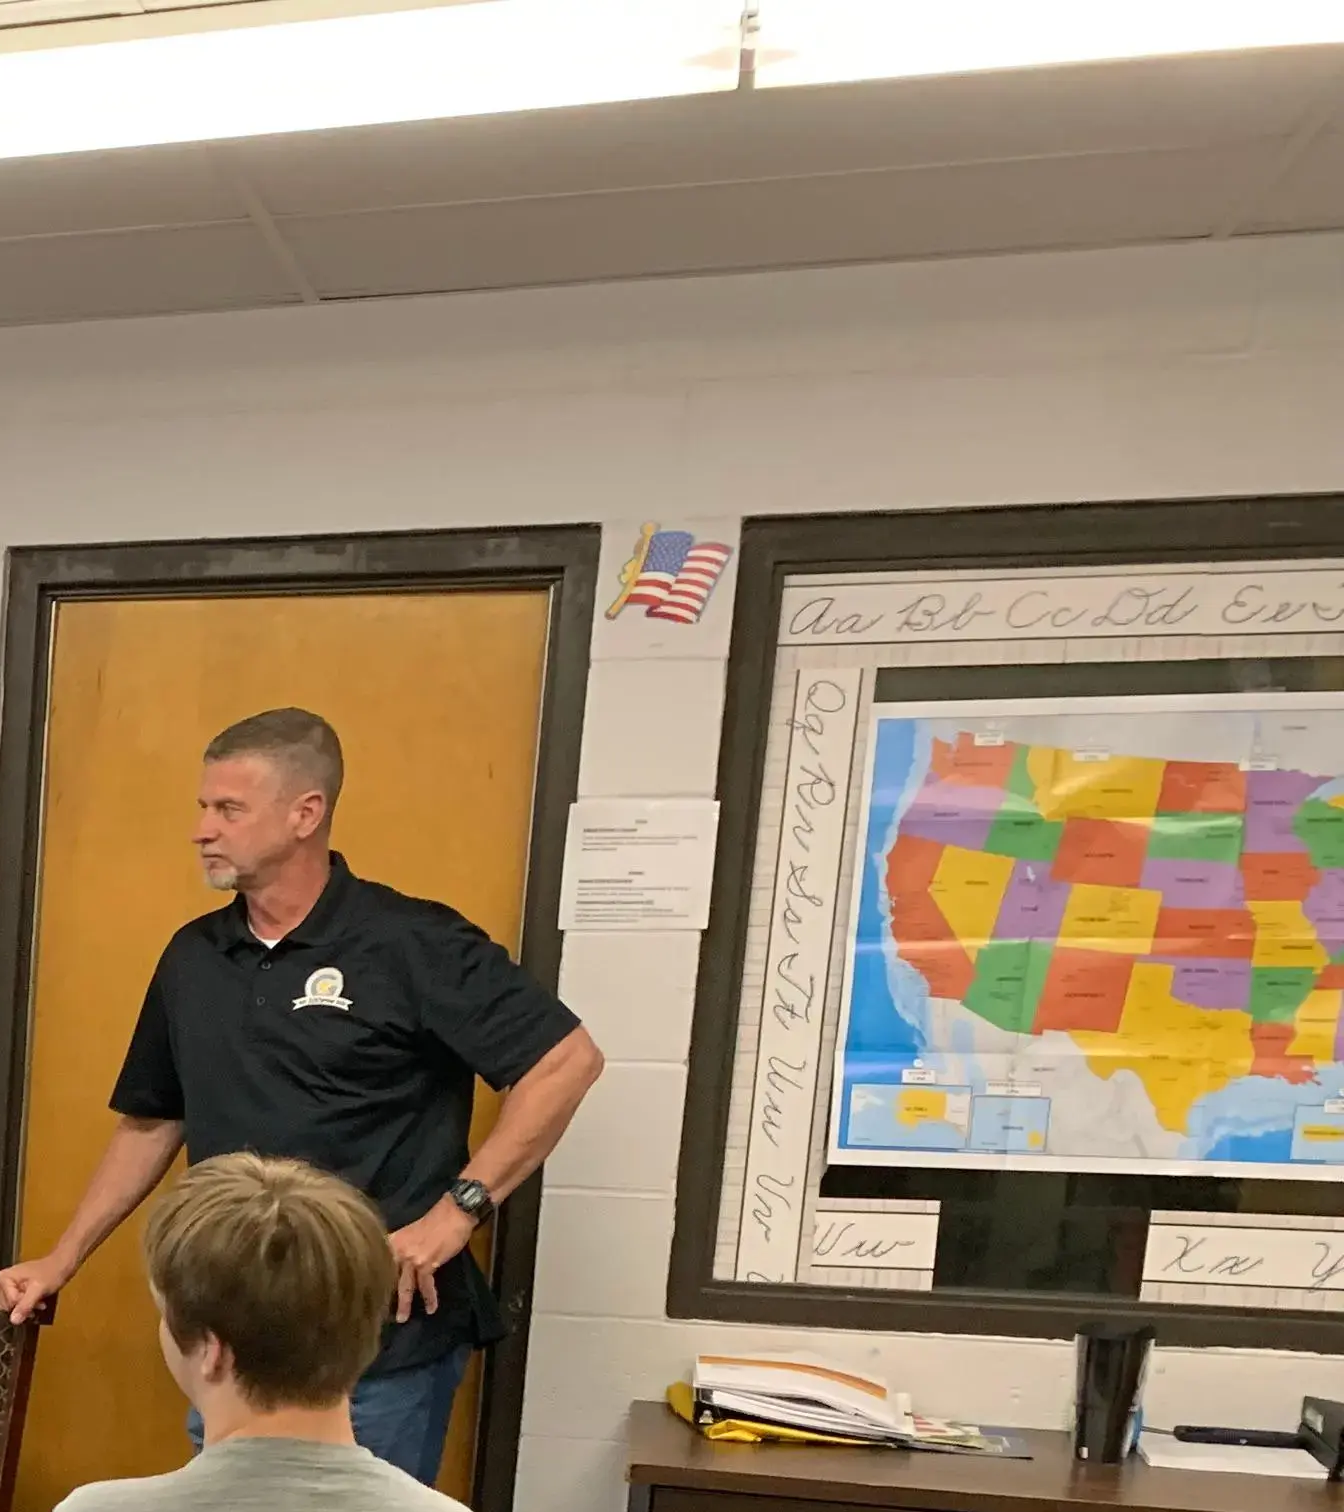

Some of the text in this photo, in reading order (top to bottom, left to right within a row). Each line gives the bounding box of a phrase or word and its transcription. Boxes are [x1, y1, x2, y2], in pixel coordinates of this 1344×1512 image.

[789, 597, 883, 635] Aa
[896, 593, 996, 633] Bb
[1006, 590, 1088, 629] Cc
[1091, 586, 1198, 627] Dd
